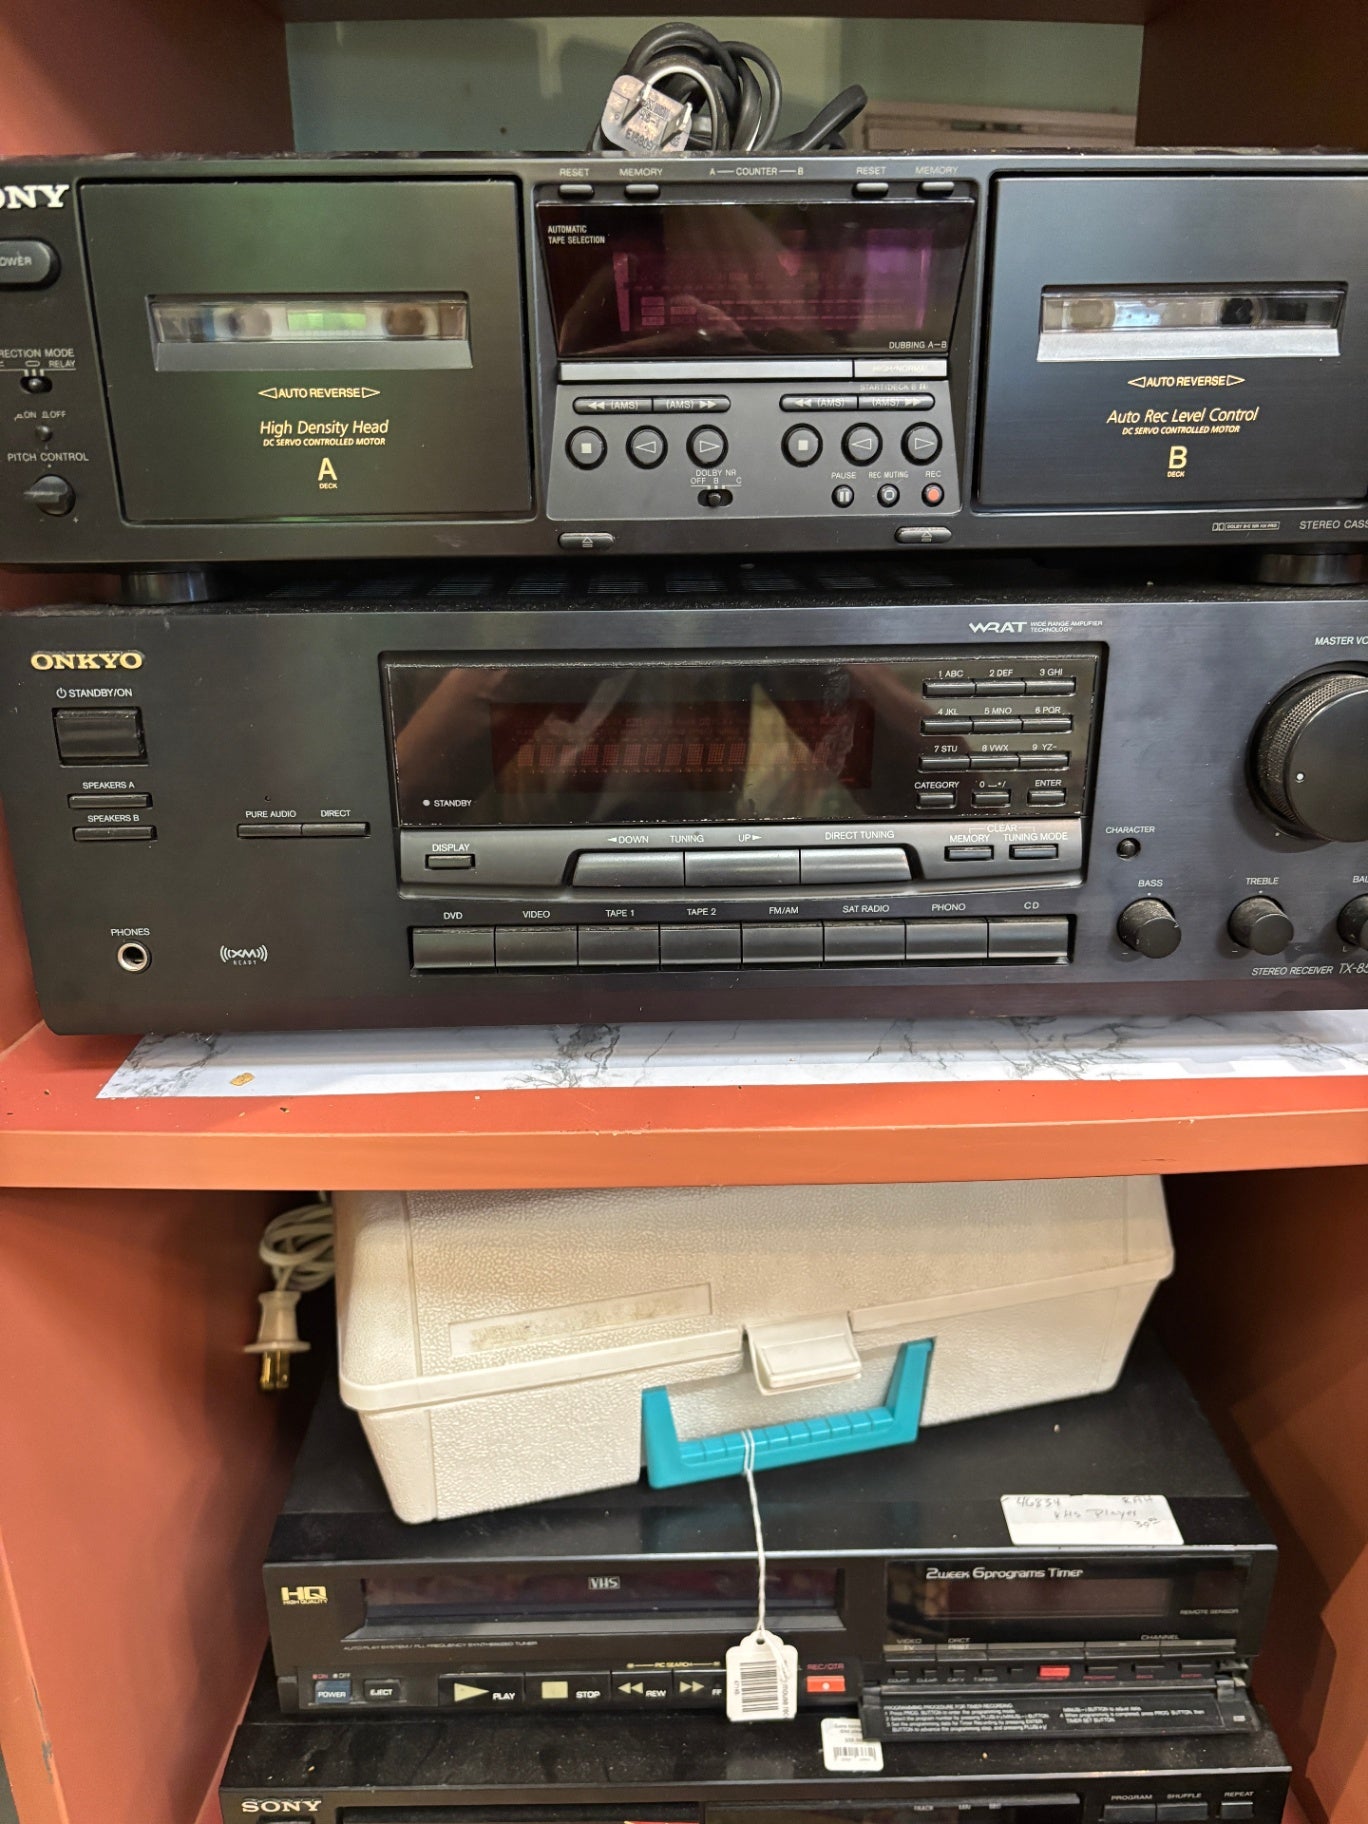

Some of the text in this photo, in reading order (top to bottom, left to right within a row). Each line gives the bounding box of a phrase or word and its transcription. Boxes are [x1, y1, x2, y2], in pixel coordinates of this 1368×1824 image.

[559, 168, 664, 177] RESET MEMORY
[735, 167, 778, 177] COUNTER
[856, 166, 959, 176] RESET MEMORY
[0, 184, 70, 209] NY
[547, 225, 588, 234] AUTOMATIC
[548, 236, 606, 244] TAPE SELECTION
[889, 341, 926, 350] DUBBING
[45, 347, 75, 358] MODE
[48, 359, 76, 368] RELAY
[1146, 375, 1227, 388] AUTO REVERSE
[278, 387, 361, 399] AUTO REVERSE
[24, 410, 37, 419] ON
[50, 410, 67, 418] OFF
[1106, 405, 1260, 424] Auto Rec Level Control
[260, 418, 390, 438] High Density Head
[1121, 425, 1241, 435] DC SERVO CONTROLLED MOTOR
[262, 437, 386, 447] DC SERVO CONTROLLED MOTOR
[7, 452, 89, 462] PITCH CONTROL
[1168, 445, 1188, 470] B
[317, 457, 338, 482] A
[695, 469, 737, 477] DOLBY NR
[925, 470, 942, 478] REC
[830, 471, 857, 480] PAUSE
[868, 471, 909, 479] REC MUTING
[690, 477, 742, 485] OFF B C
[1299, 520, 1341, 530] STEREO
[968, 621, 1028, 634] WRAT
[1314, 636, 1355, 646] MASTER
[30, 652, 144, 671] ONKYO
[944, 669, 964, 678] ABC
[989, 669, 1014, 677] 2 DEF
[1047, 668, 1063, 676] GHI
[69, 689, 133, 699] STANDBY/ON
[989, 744, 1009, 752] VWX
[82, 781, 135, 790] SPEAKERS A
[914, 781, 960, 790] CATEGORY
[1035, 779, 1062, 787] ENTER
[433, 799, 472, 808] STANDBY
[245, 810, 297, 818] PURE AUDIO
[320, 809, 351, 817] DIRECT
[87, 814, 139, 823] SPEAKERS B
[986, 824, 1018, 833] CLEAR
[1105, 825, 1156, 834] CHARACTER
[618, 834, 751, 844] DOWN TUNING UP
[825, 830, 895, 841] DIRECT TUNING
[950, 833, 991, 843] MEMORY
[1003, 831, 1068, 842] TUNING MODE
[432, 843, 470, 852] DISPLAY
[1138, 879, 1163, 888] BASS
[1246, 877, 1280, 886] TREBLE
[842, 904, 890, 914] SAT RADIO
[931, 903, 966, 912] PHONO
[1023, 901, 1040, 910] CD
[522, 911, 551, 919] VIDEO
[605, 909, 628, 918] TAPE
[687, 908, 717, 916] TAPE 2
[768, 906, 799, 915] FM/AM
[443, 912, 463, 920] DVD
[110, 928, 151, 937] PHONES
[1251, 965, 1334, 976] STEREO RECEIVER
[1047, 1567, 1084, 1578] Timer
[588, 1576, 620, 1590] VHS
[281, 1586, 328, 1602] HQ
[370, 1688, 393, 1696] EJECT
[492, 1692, 516, 1700] PLAY
[575, 1691, 600, 1699] STOP
[711, 1688, 722, 1696] FF
[241, 1800, 322, 1813] SONY
